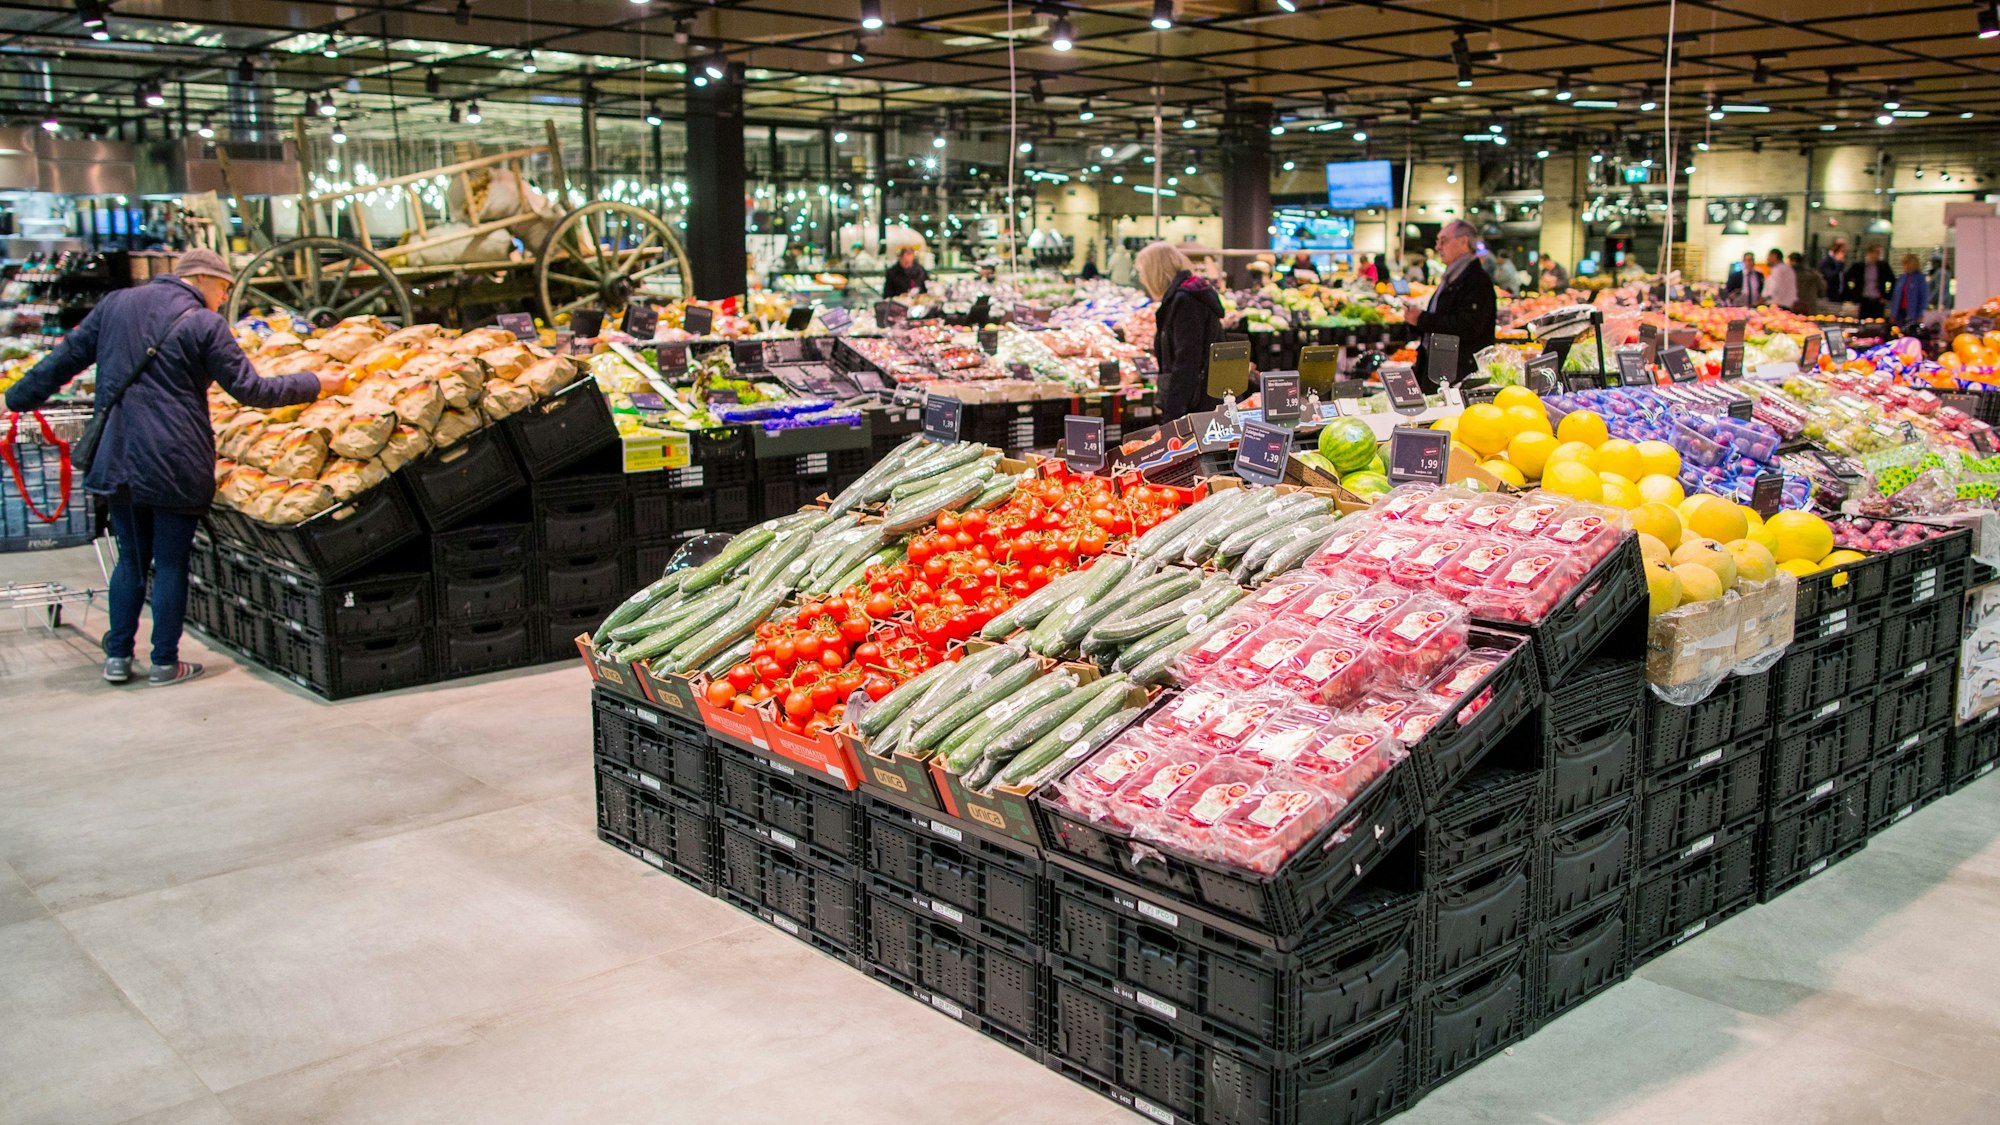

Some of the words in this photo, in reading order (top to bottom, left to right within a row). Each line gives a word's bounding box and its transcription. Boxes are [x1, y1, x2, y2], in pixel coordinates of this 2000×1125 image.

[1286, 398, 1299, 408] 3,99
[943, 419, 954, 429] 1,39
[1204, 417, 1235, 444] Alizé
[1084, 441, 1098, 451] 2,49
[1263, 451, 1279, 464] 1,39
[1420, 458, 1438, 470] 1,99
[877, 770, 904, 789] unica
[970, 805, 1001, 826] unica
